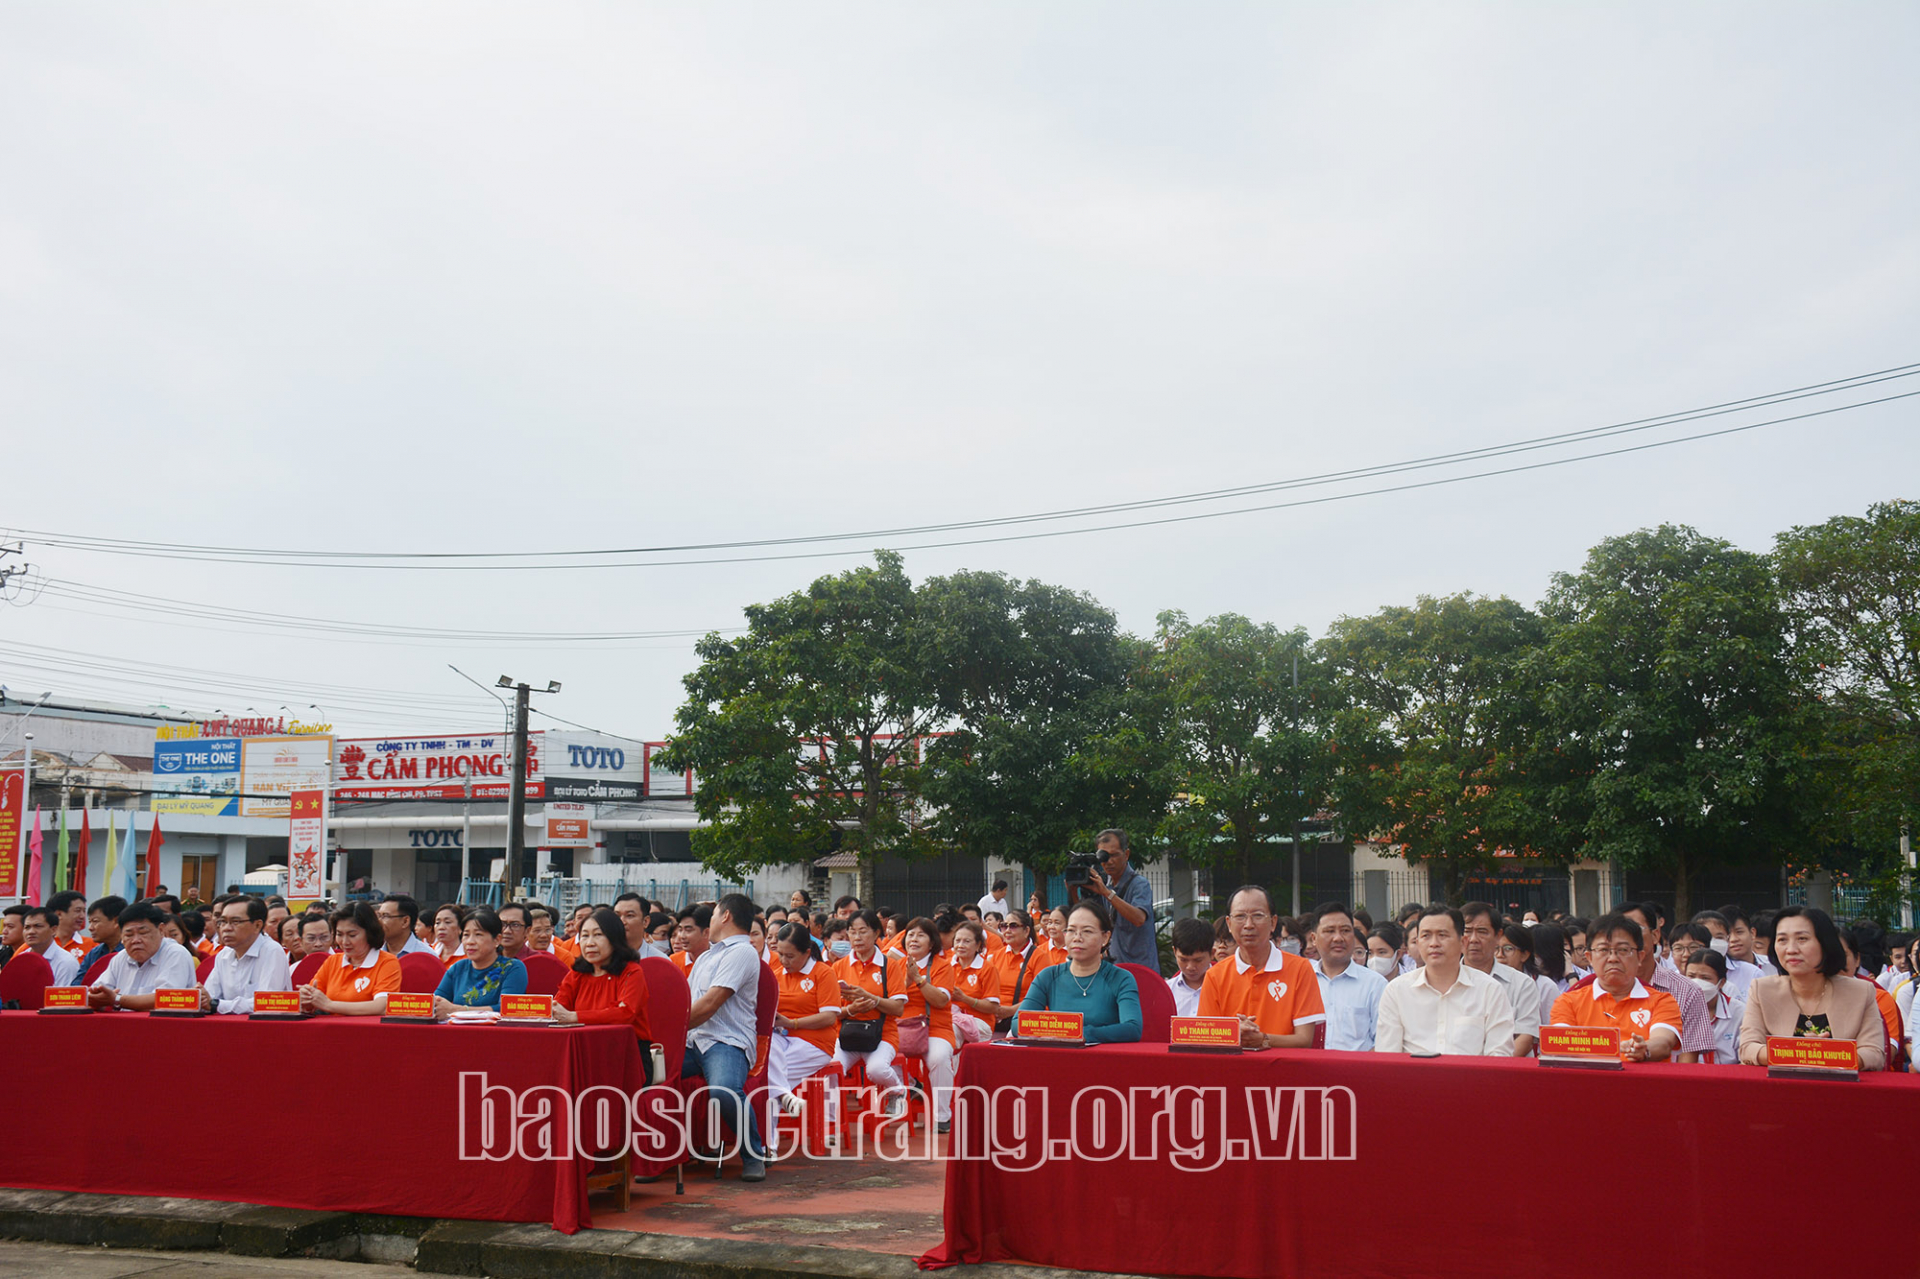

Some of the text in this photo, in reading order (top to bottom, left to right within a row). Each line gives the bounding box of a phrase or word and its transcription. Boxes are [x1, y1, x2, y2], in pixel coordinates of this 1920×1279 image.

[211, 714, 229, 737] MỸ
[231, 717, 274, 737] QUANG
[376, 740, 402, 752] CÔNG
[405, 741, 417, 750] TY
[421, 740, 446, 750] TNHH
[456, 739, 471, 749] TM
[481, 738, 494, 748] DV
[185, 752, 236, 764] THE ONE
[568, 744, 625, 770] TOTO
[367, 750, 418, 780] CẨM
[425, 754, 503, 778] PHONG
[608, 787, 638, 797] PHONG
[1040, 1020, 1048, 1030] THỊ
[1189, 1027, 1210, 1035] THANH
[1210, 1028, 1232, 1036] QUANG
[1548, 1036, 1570, 1046] PHẠM
[1571, 1037, 1590, 1045] MINH
[1774, 1048, 1852, 1060] TRỊNH THỊ BẢO KHUYÊN
